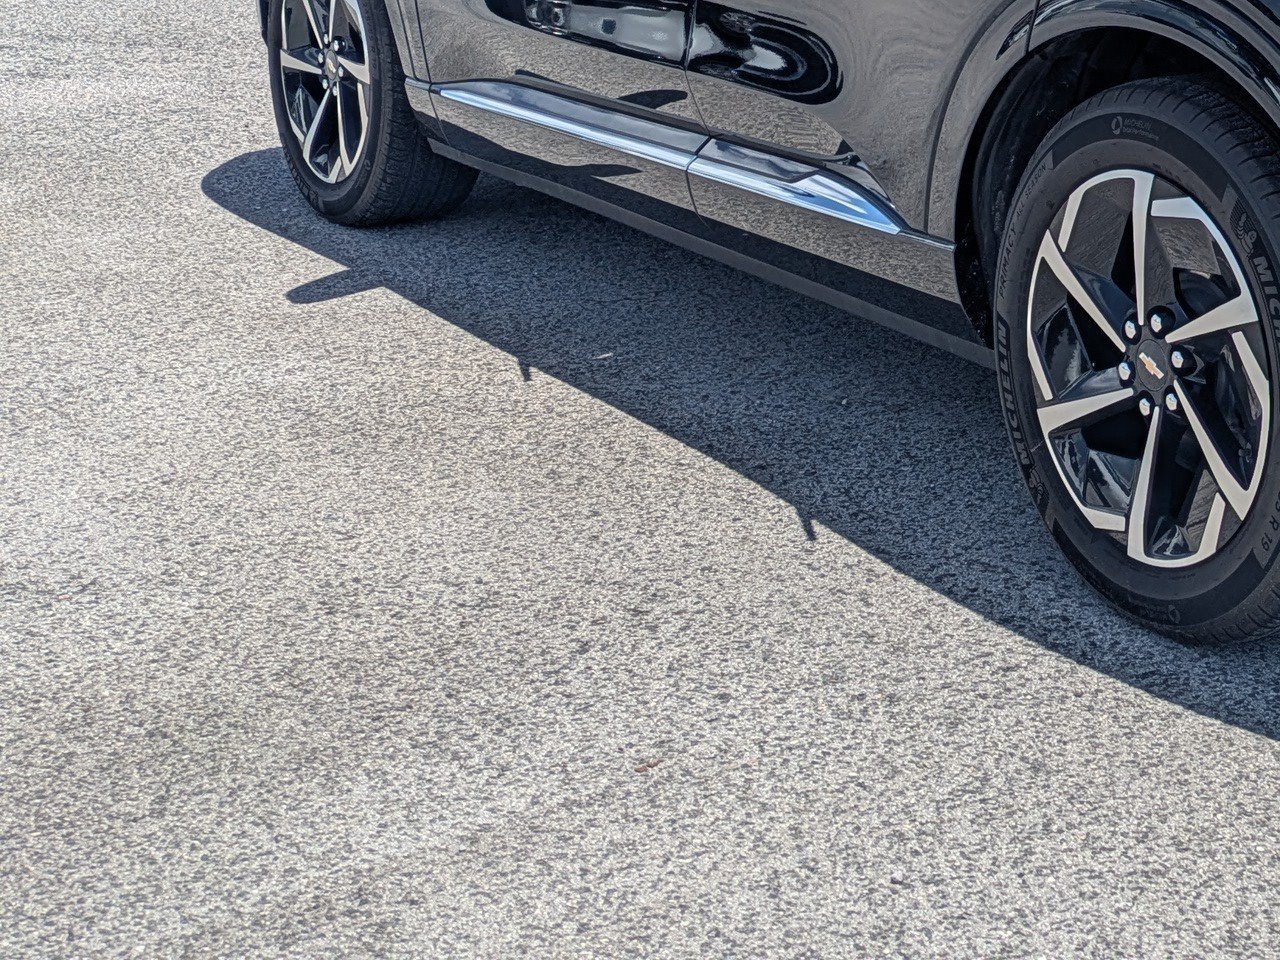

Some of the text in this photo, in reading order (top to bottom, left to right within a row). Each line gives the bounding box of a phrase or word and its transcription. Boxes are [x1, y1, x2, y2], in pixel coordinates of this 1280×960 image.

[999, 223, 1016, 299] PRIMACY
[997, 318, 1030, 466] MICHELIN
[1269, 515, 1280, 531] R
